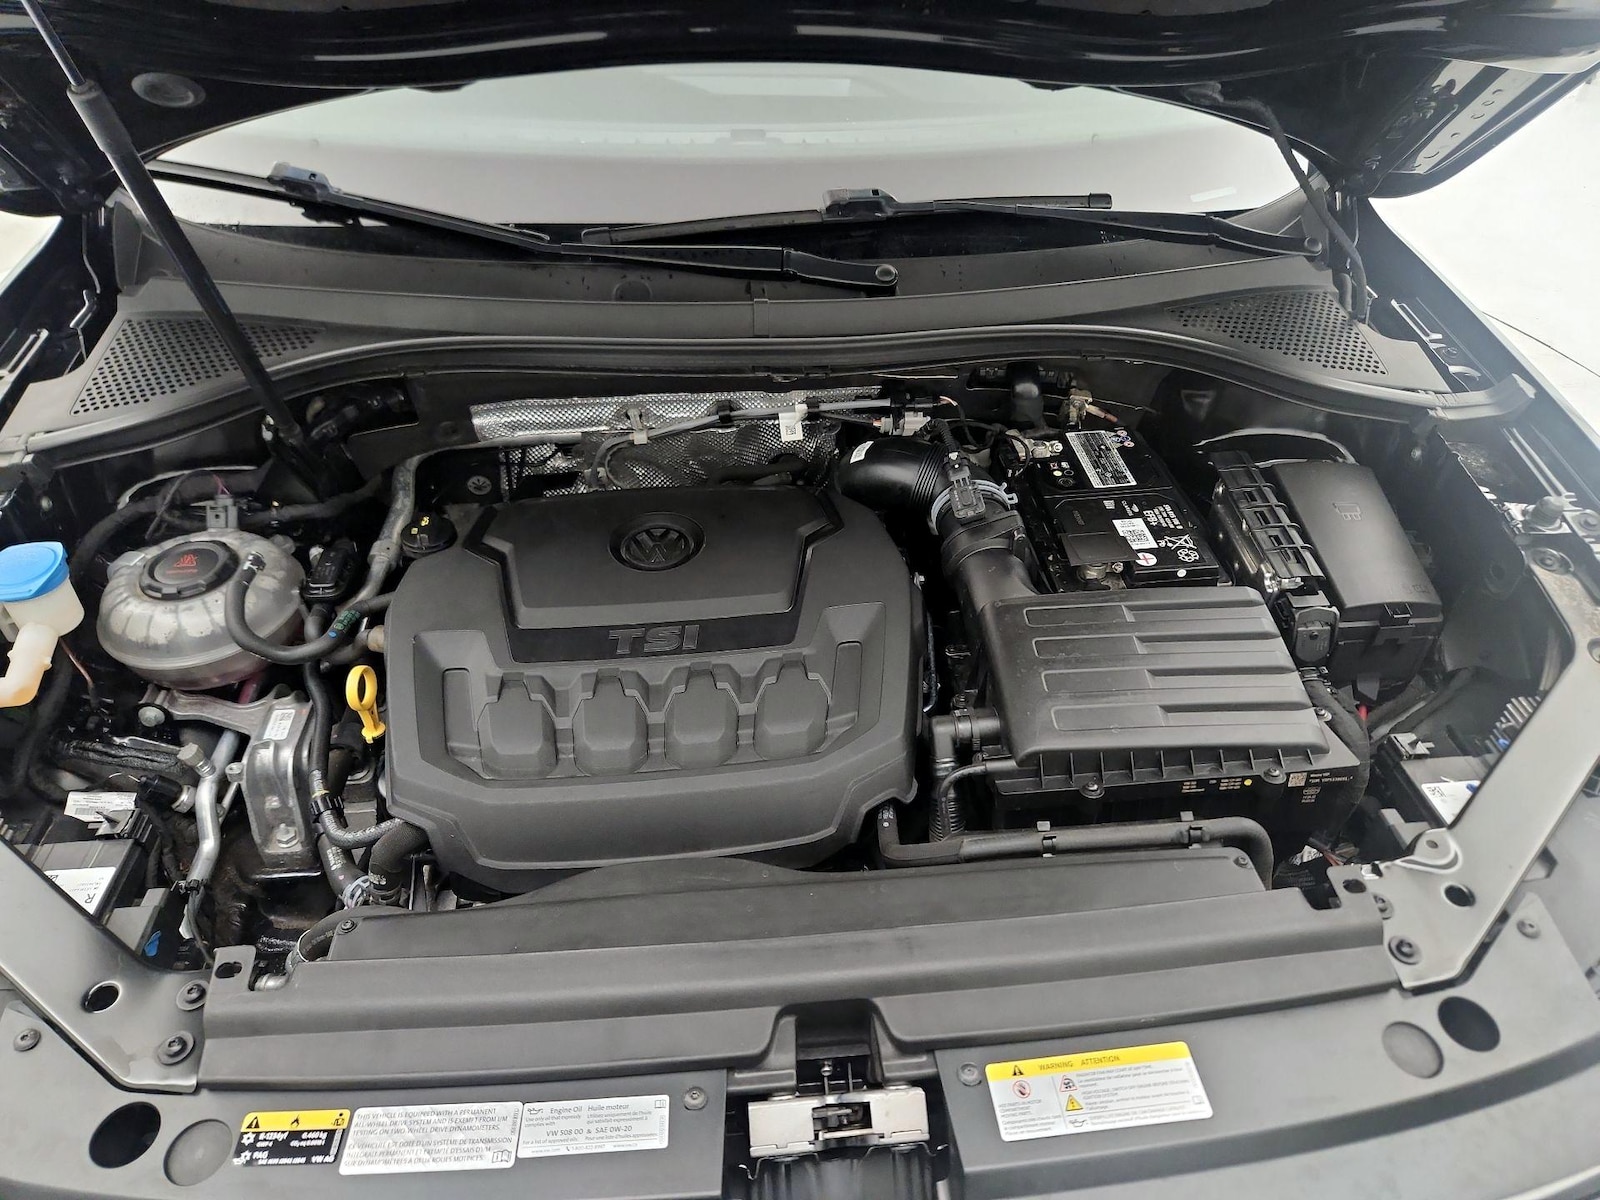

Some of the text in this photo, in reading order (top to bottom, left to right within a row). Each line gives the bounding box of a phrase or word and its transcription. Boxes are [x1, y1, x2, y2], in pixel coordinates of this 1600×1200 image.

[1143, 510, 1158, 526] EFB+
[608, 624, 700, 654] TSI
[84, 893, 96, 904] R
[1038, 1056, 1120, 1070] WARNING ATTENTION
